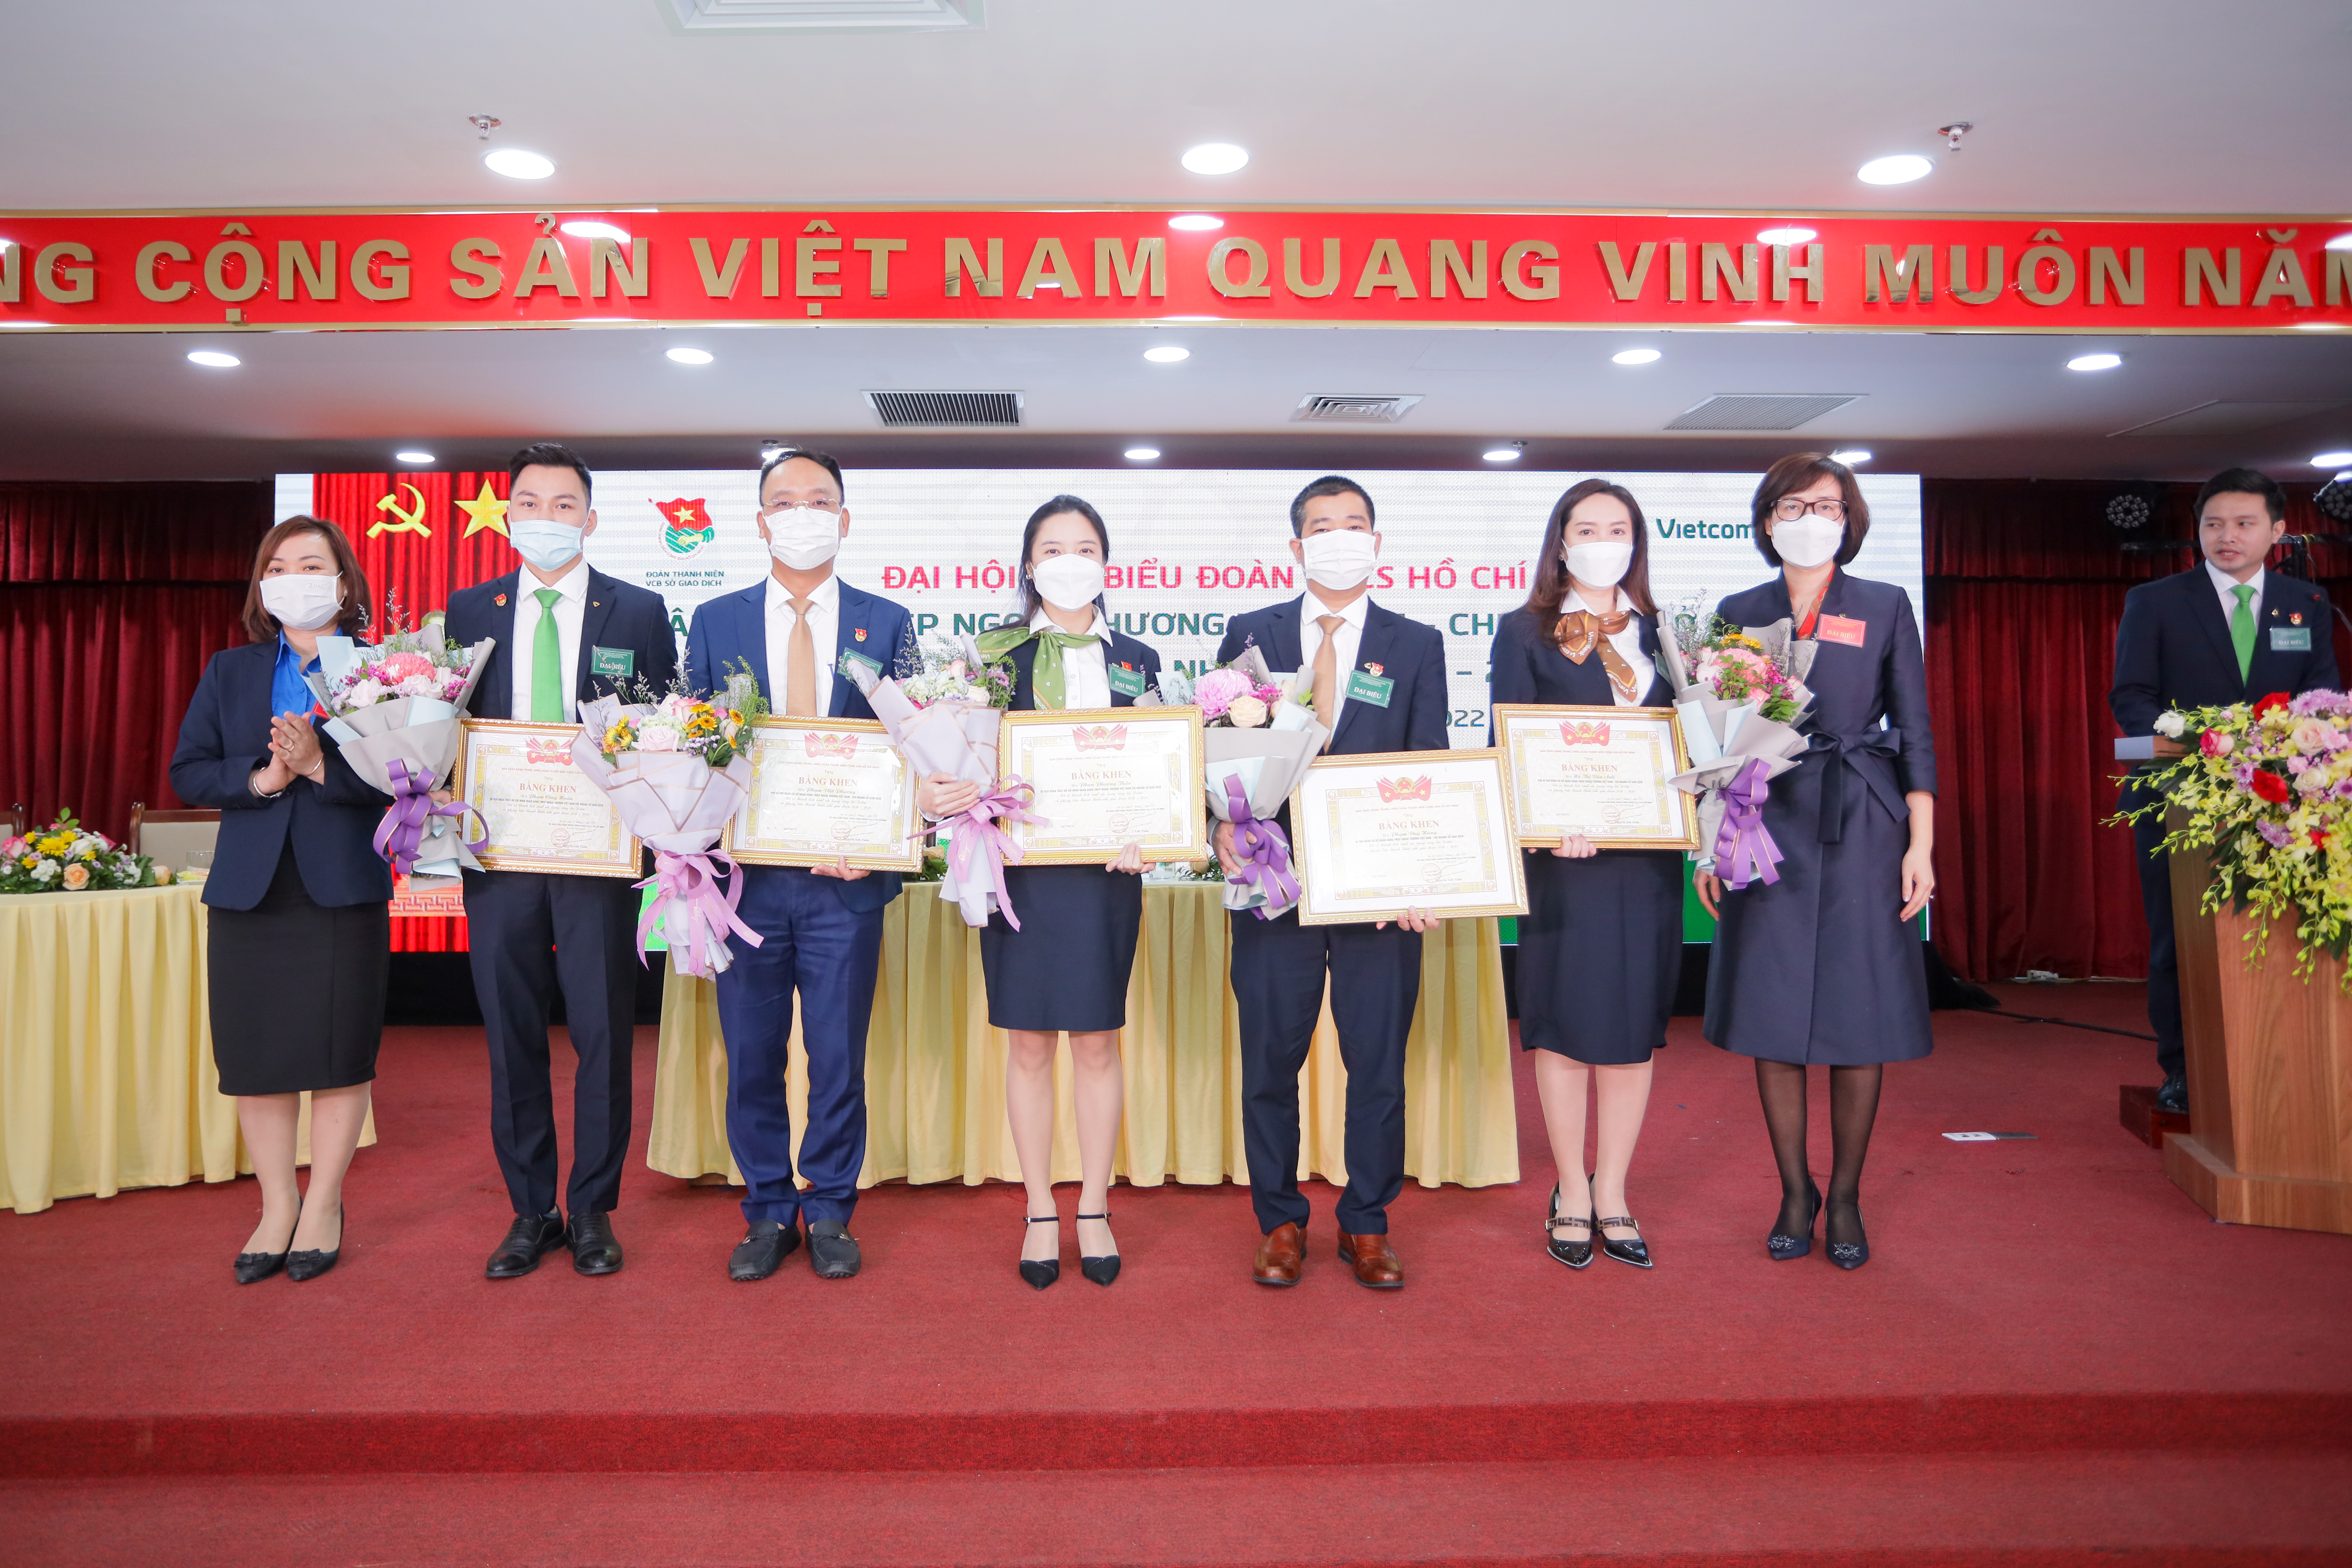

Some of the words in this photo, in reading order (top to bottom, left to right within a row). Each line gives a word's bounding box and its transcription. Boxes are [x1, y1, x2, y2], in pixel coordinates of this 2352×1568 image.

[135, 222, 411, 323] CỘNG
[450, 213, 648, 299] SẢN
[689, 220, 907, 316] VIỆT
[945, 237, 1165, 299] NAM
[1207, 236, 1560, 301] QUANG
[1597, 241, 1824, 303] VINH
[1865, 229, 2145, 306] MUÔN
[1656, 518, 1755, 538] Vietcom
[882, 566, 940, 593] ĐẠI
[955, 559, 1015, 593] HỘI
[1104, 557, 1181, 589] BIỂU
[1196, 560, 1293, 589] ĐOÀN
[1408, 557, 1456, 589] HỒ
[1471, 560, 1526, 589] CHÍ
[1449, 613, 1493, 635] CH
[1561, 761, 1588, 771] BẰNG
[798, 774, 826, 785] BẰNG
[829, 778, 857, 786] KHEN
[1071, 769, 1099, 779] BẰNG
[519, 780, 546, 791] BẰNG
[1378, 819, 1407, 829] BẰNG
